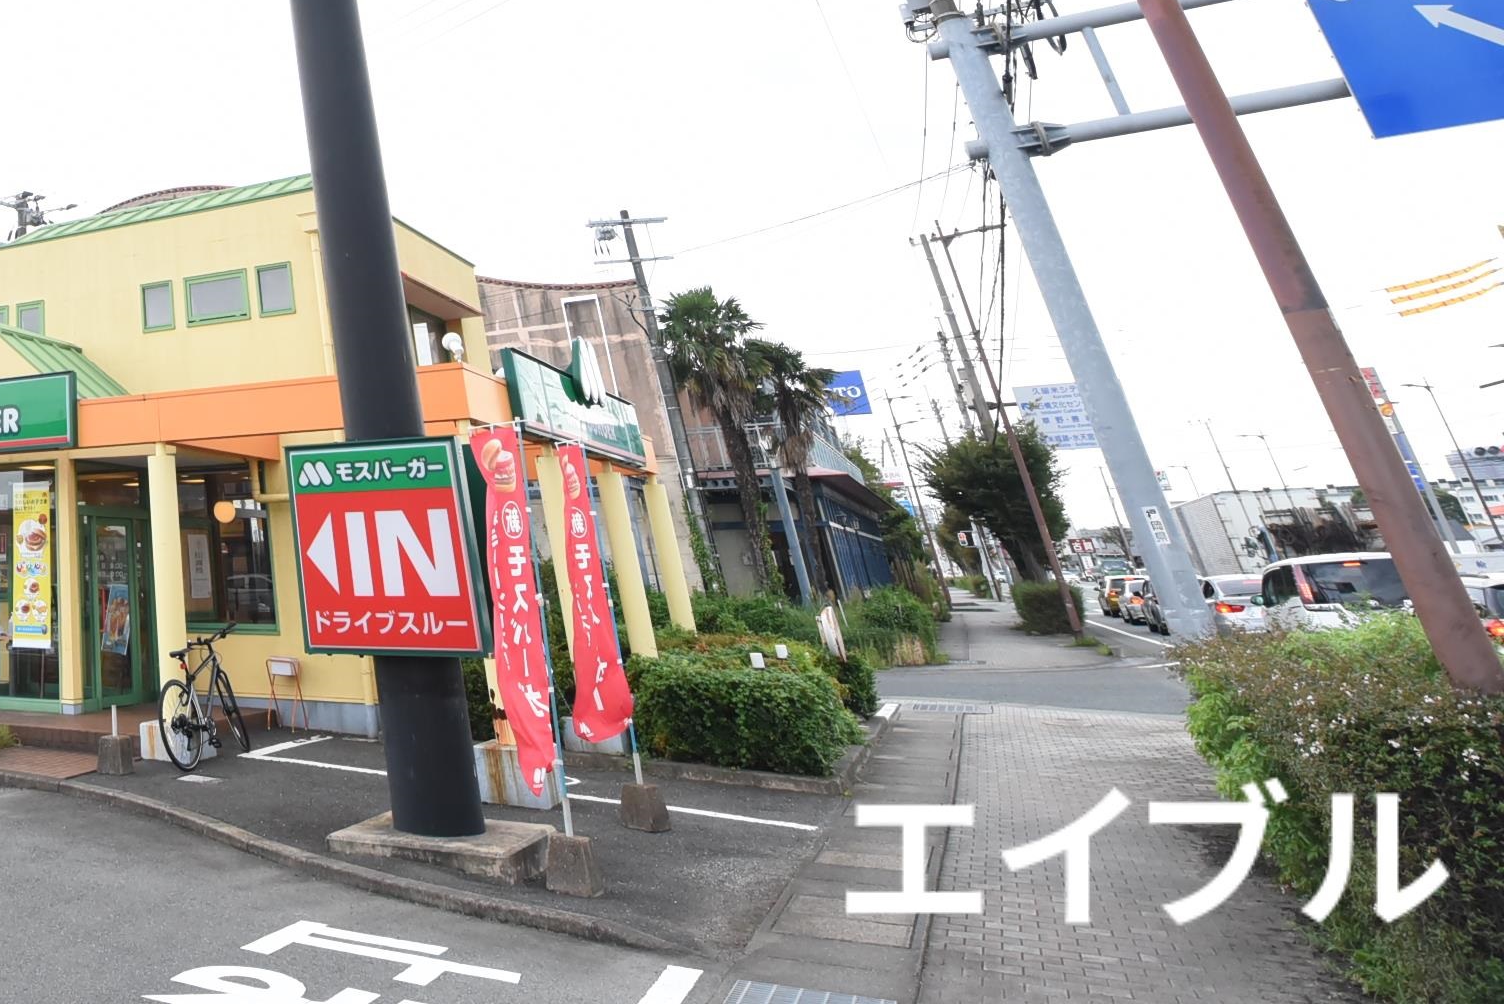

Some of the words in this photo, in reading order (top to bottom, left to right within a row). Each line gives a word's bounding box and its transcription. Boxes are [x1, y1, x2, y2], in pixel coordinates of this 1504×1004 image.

[335, 457, 444, 482] モスバーガー
[345, 508, 461, 597] IN
[314, 609, 469, 636] ドライブスルー
[507, 545, 551, 732] モスバーガ
